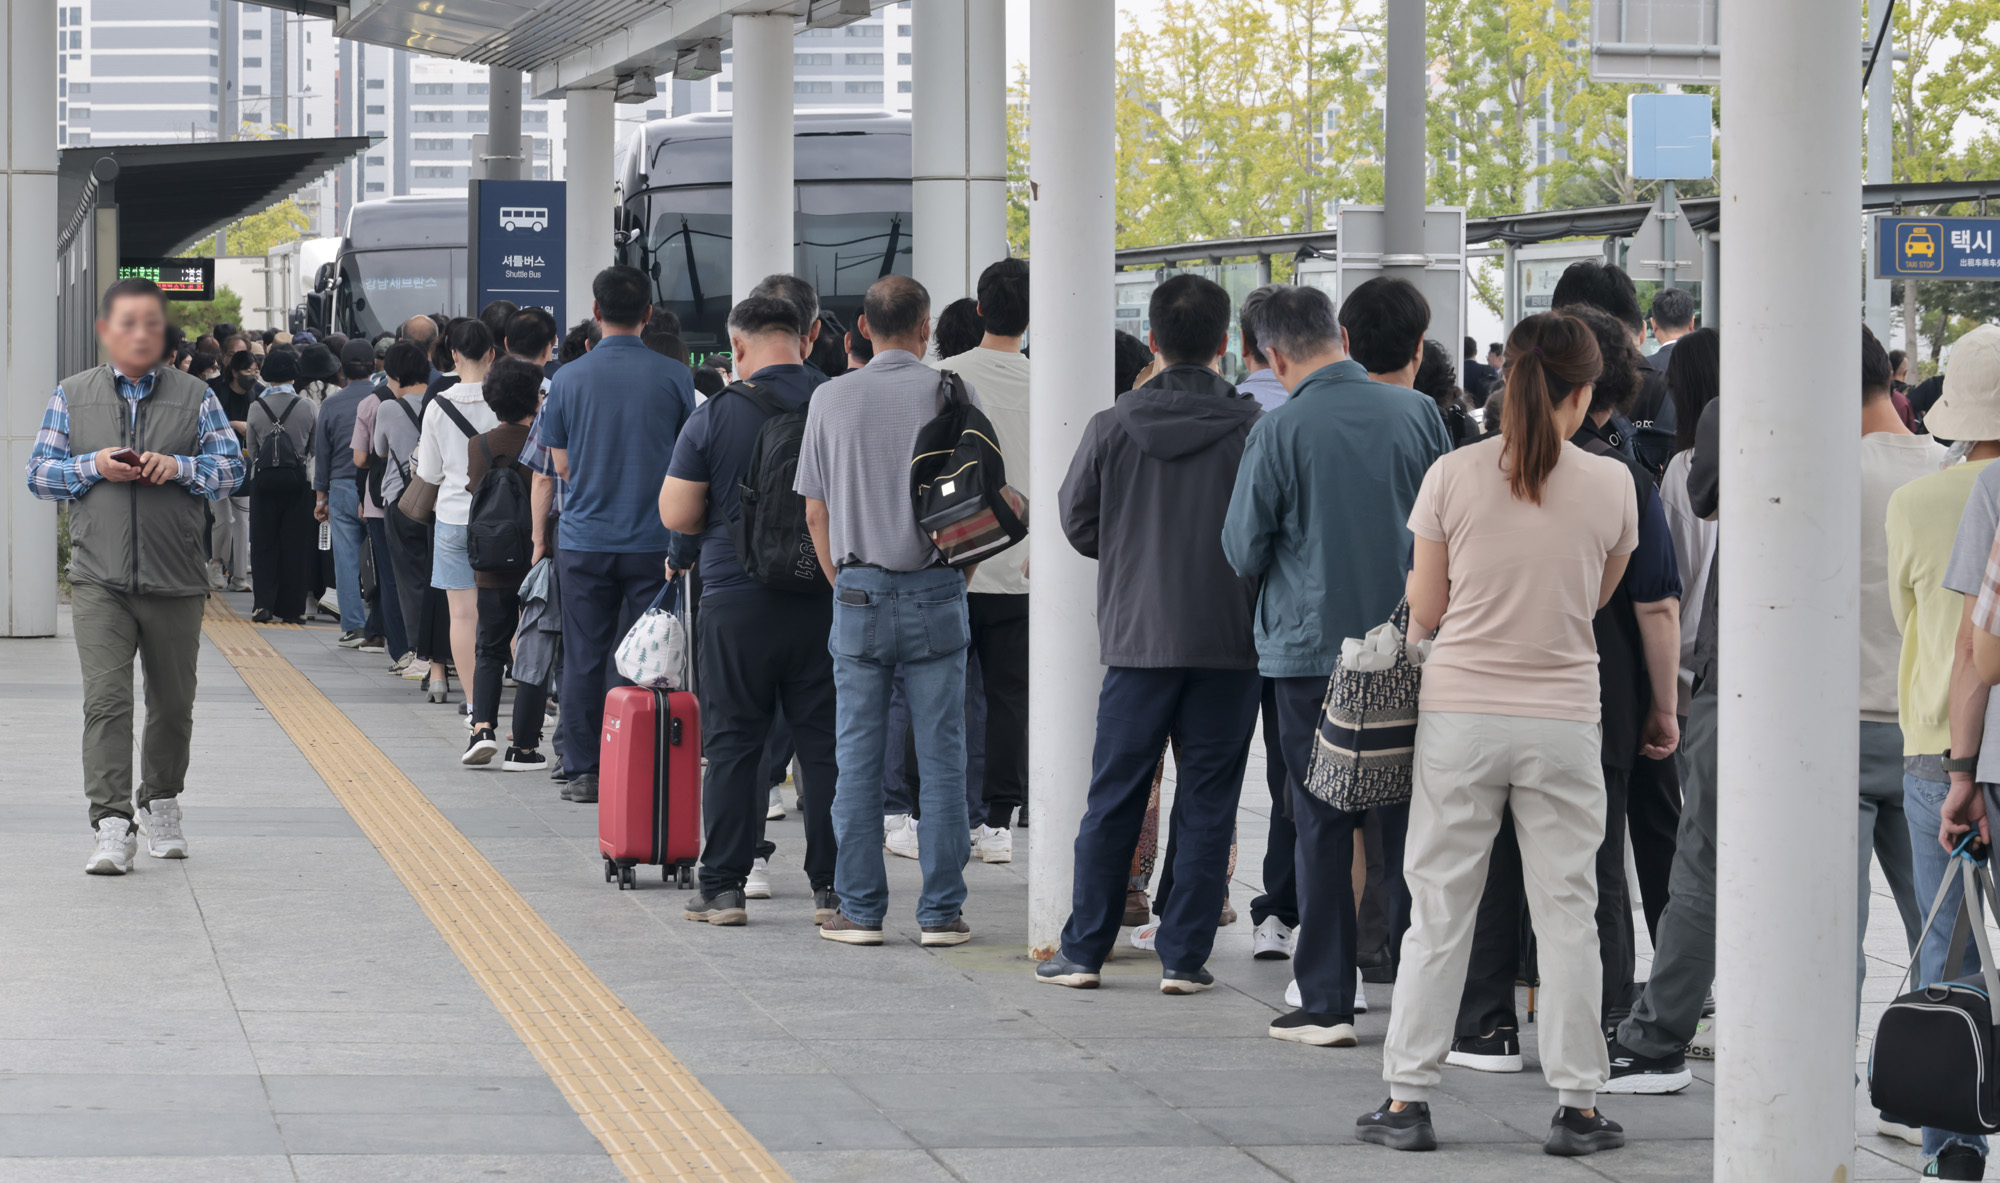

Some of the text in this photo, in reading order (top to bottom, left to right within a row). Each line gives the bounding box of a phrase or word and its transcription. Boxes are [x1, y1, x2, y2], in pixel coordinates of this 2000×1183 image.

[1951, 229, 1992, 254] 택시
[502, 255, 546, 267] 셔틀버스
[505, 270, 542, 278] Shuttle Bus
